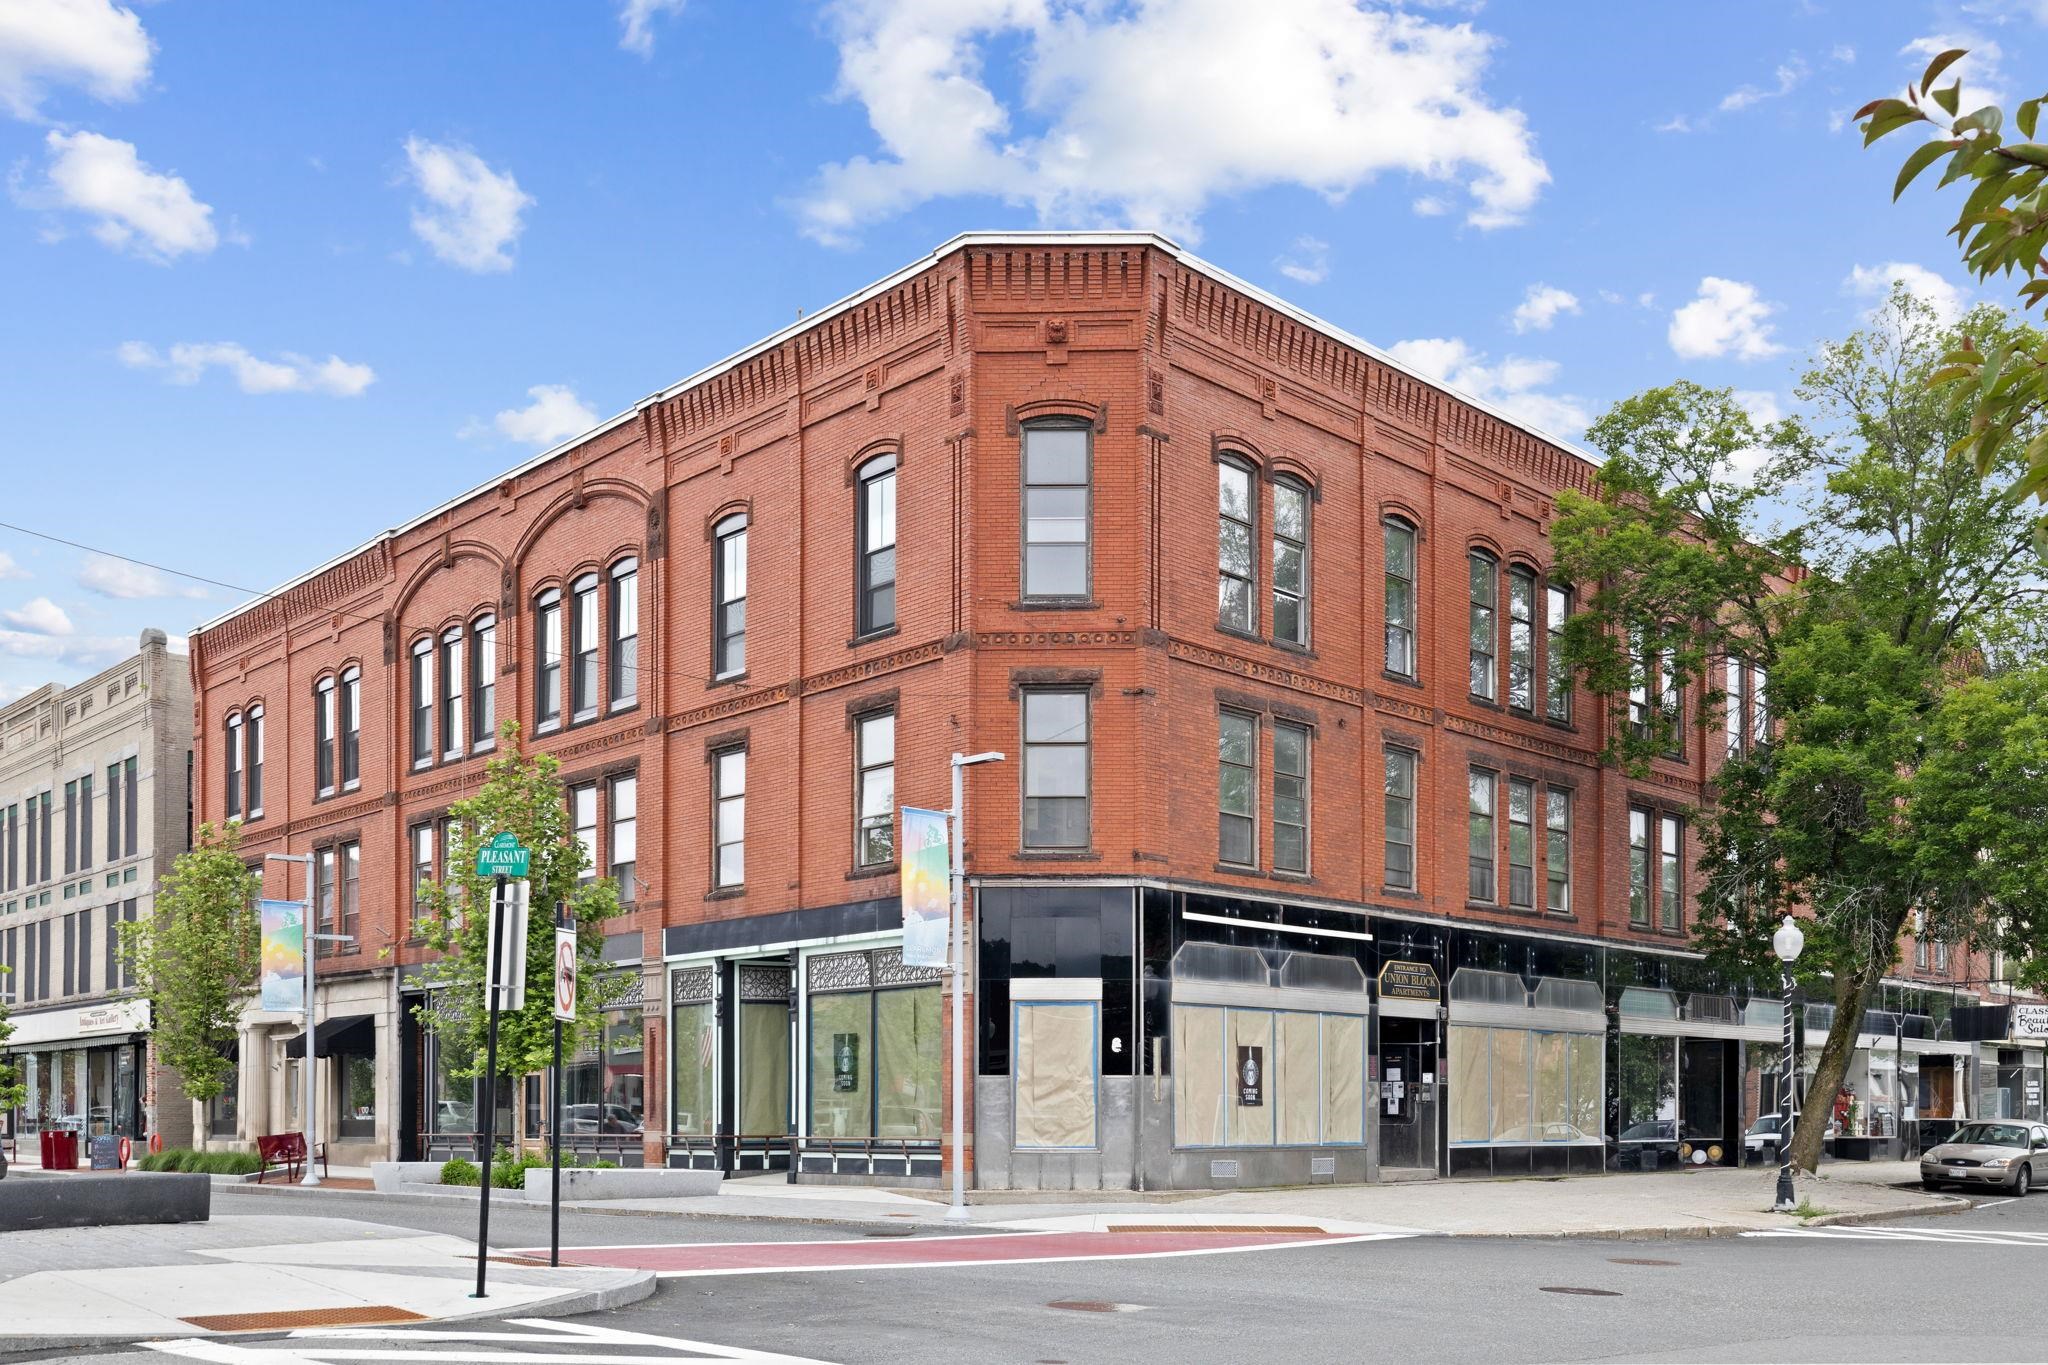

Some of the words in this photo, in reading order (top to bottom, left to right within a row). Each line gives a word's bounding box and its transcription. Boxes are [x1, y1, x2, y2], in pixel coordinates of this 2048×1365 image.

[481, 850, 527, 864] PLEASANT
[492, 865, 513, 874] STREET
[1394, 964, 1419, 972] ENTRANCE
[1385, 972, 1409, 985] UNION
[1411, 975, 1436, 987] BLOCK
[1391, 988, 1430, 998] APARTMENTS
